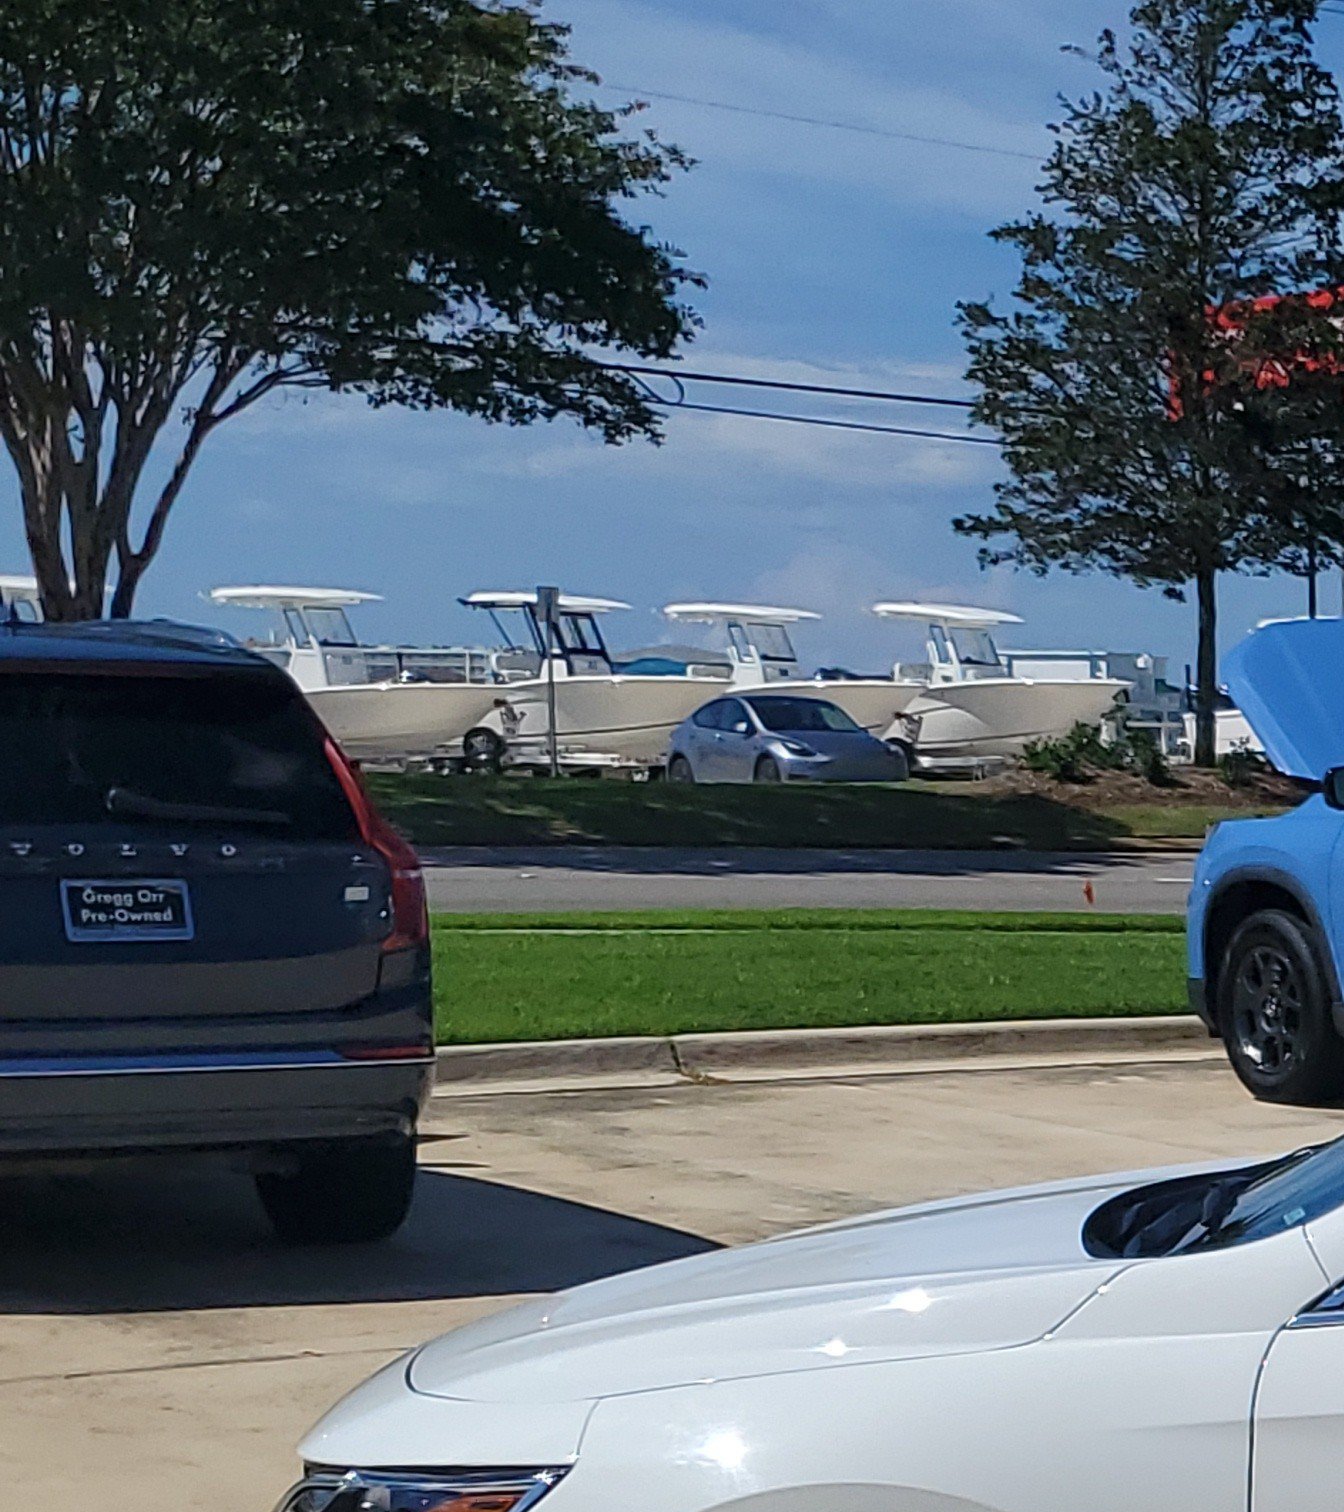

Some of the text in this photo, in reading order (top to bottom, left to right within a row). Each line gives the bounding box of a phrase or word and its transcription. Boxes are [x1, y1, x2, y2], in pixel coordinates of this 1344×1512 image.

[10, 842, 238, 857] VOLVO
[82, 888, 165, 907] Gregg Orr
[81, 906, 172, 922] Pre-Owned
